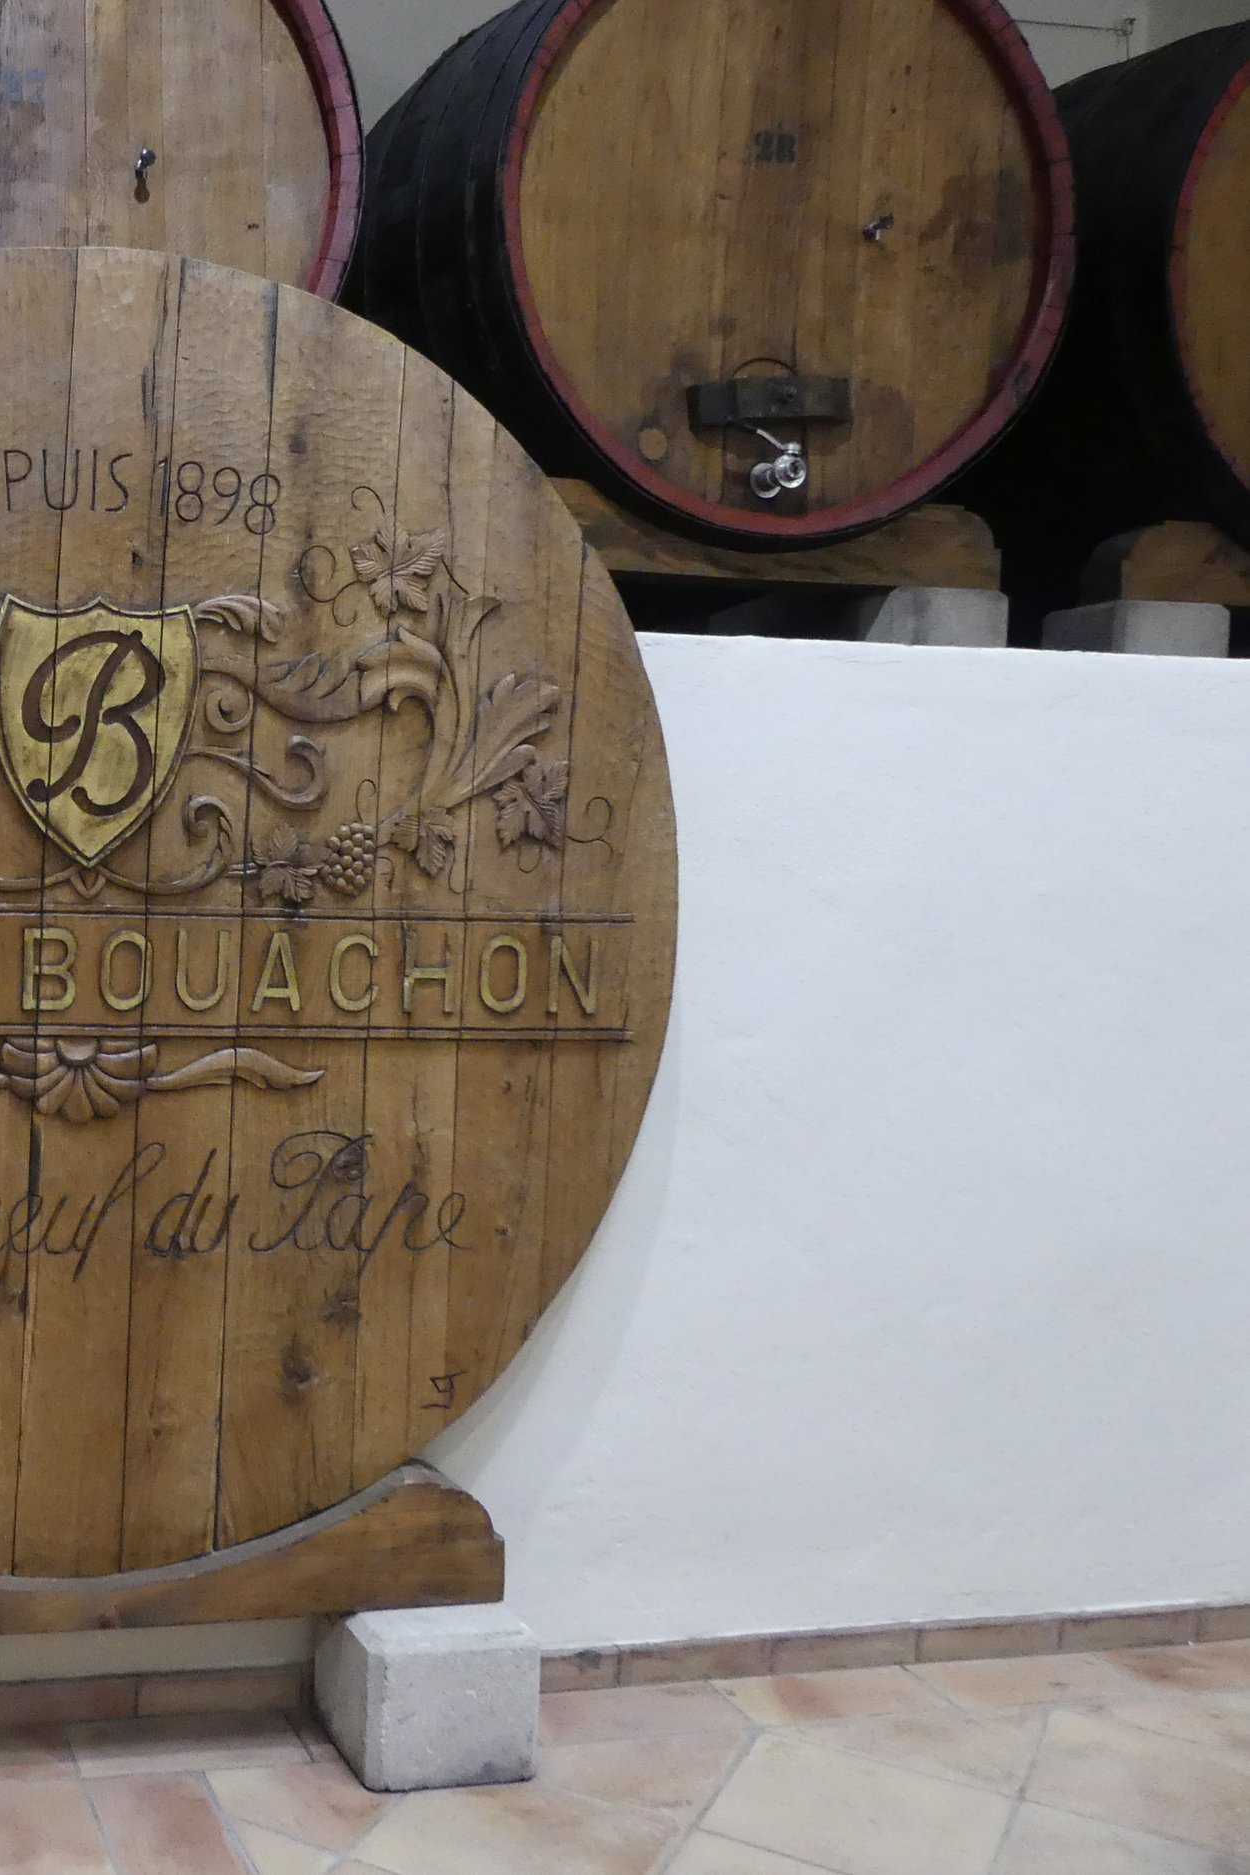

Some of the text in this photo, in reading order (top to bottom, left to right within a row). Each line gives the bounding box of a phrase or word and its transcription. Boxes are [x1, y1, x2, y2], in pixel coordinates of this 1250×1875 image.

[157, 456, 282, 536] 1898
[21, 629, 166, 817] B
[21, 926, 600, 1015] BOUACHON
[144, 1147, 240, 1258] du
[250, 1130, 472, 1279] Pape
